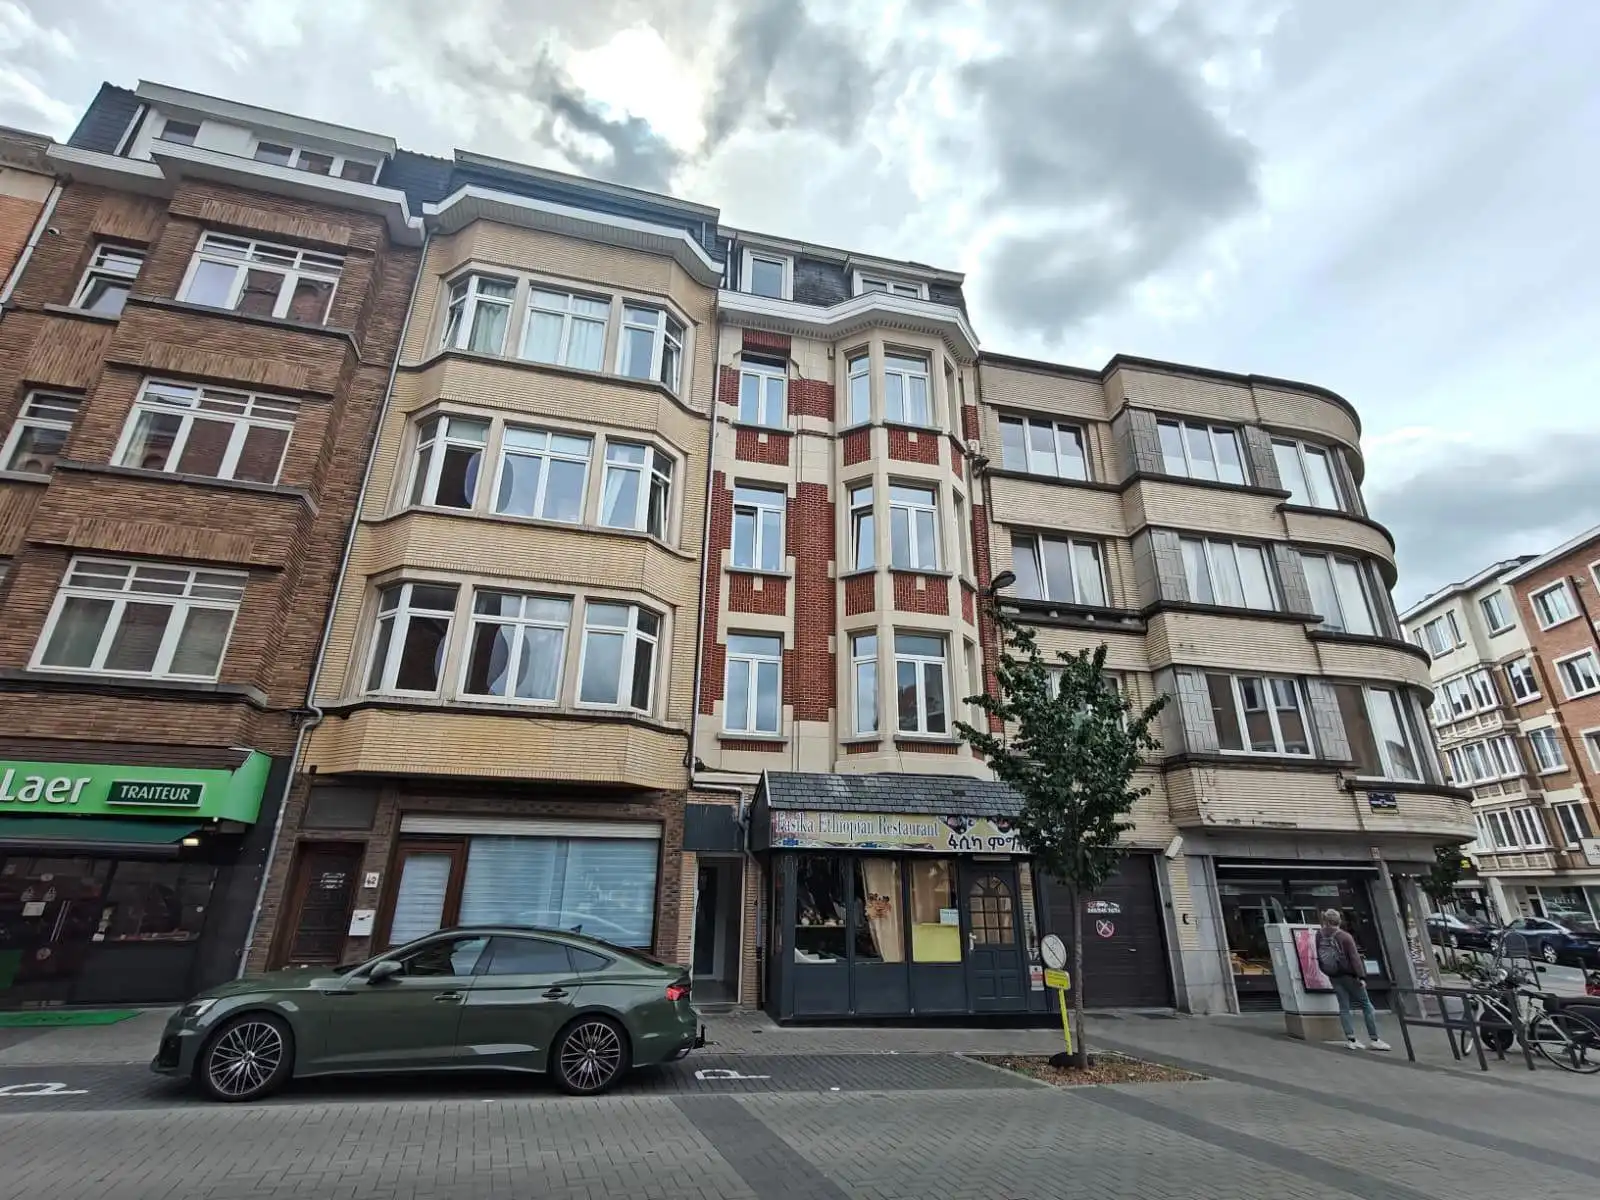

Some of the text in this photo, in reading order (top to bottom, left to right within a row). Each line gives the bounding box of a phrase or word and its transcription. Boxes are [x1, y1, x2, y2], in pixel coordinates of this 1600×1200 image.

[0, 769, 91, 804] Laer
[120, 785, 191, 801] TRAITEUR
[818, 812, 875, 840] Ethiopian
[877, 815, 939, 837] Restaurant
